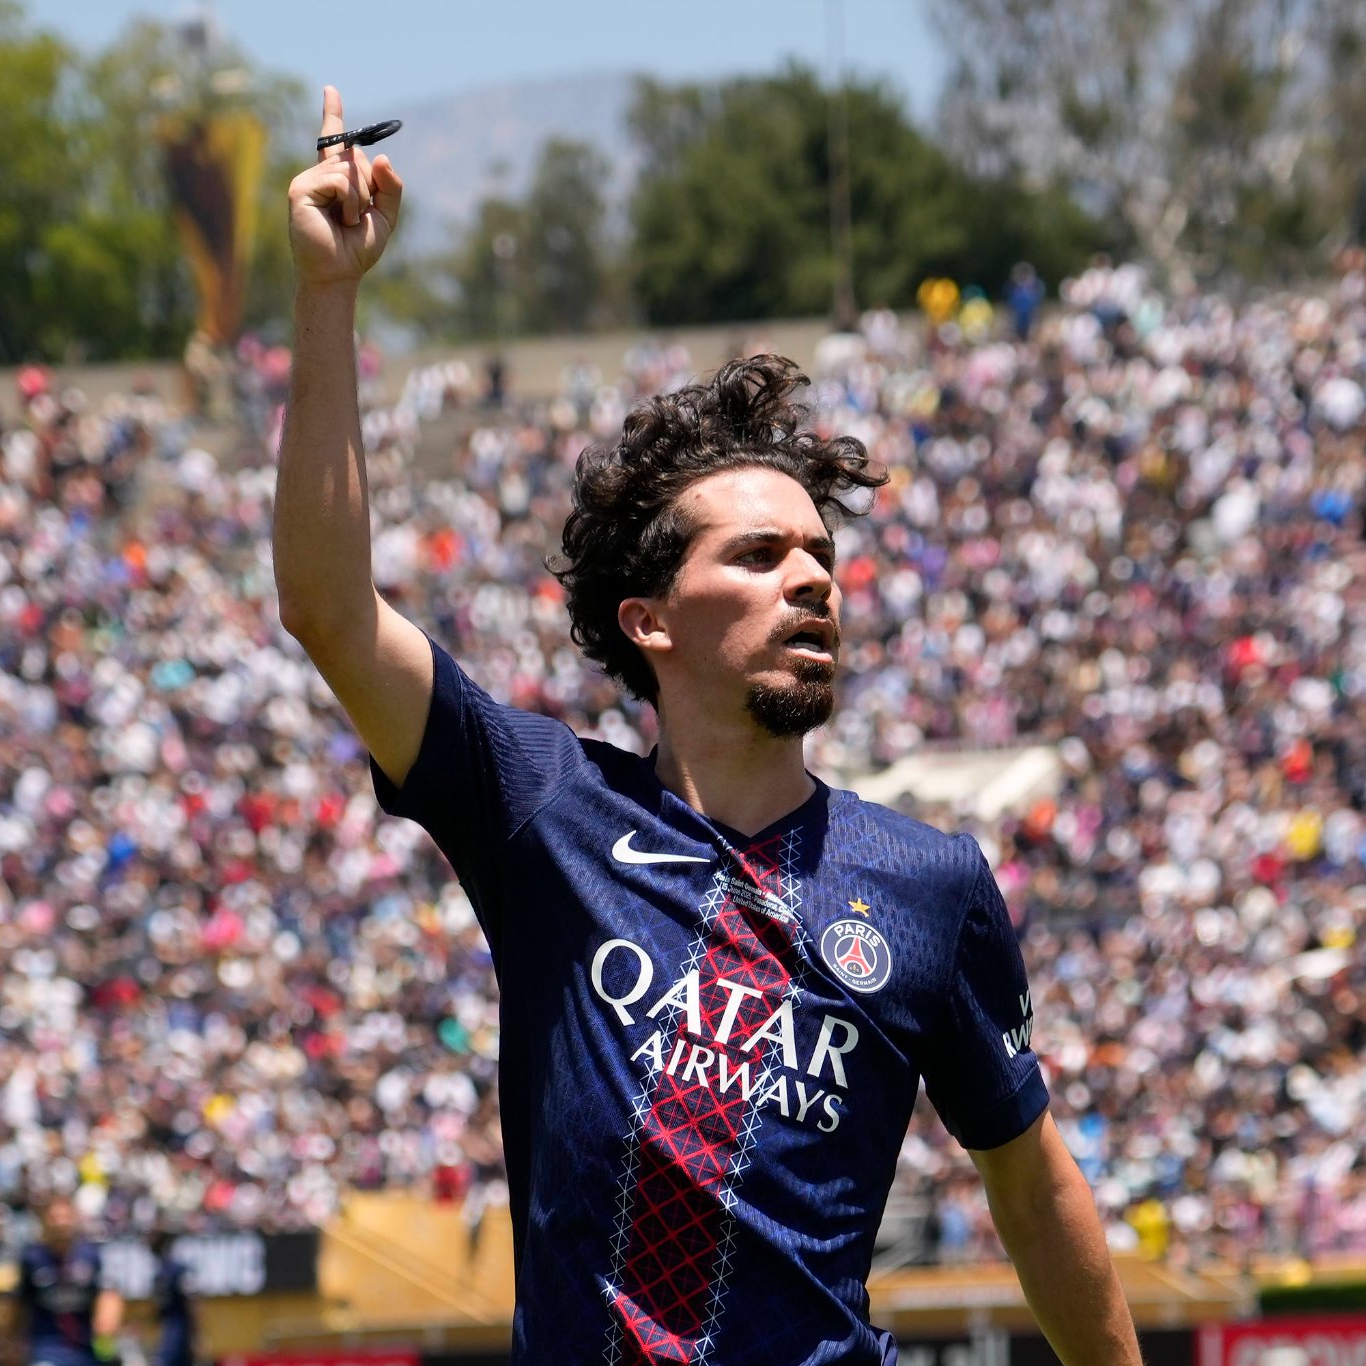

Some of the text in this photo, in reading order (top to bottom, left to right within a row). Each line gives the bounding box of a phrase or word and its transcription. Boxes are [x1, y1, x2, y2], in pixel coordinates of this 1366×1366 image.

[834, 923, 881, 947] PARIS
[591, 939, 859, 1089] QATAR
[630, 1030, 843, 1133] AIRWAYS
